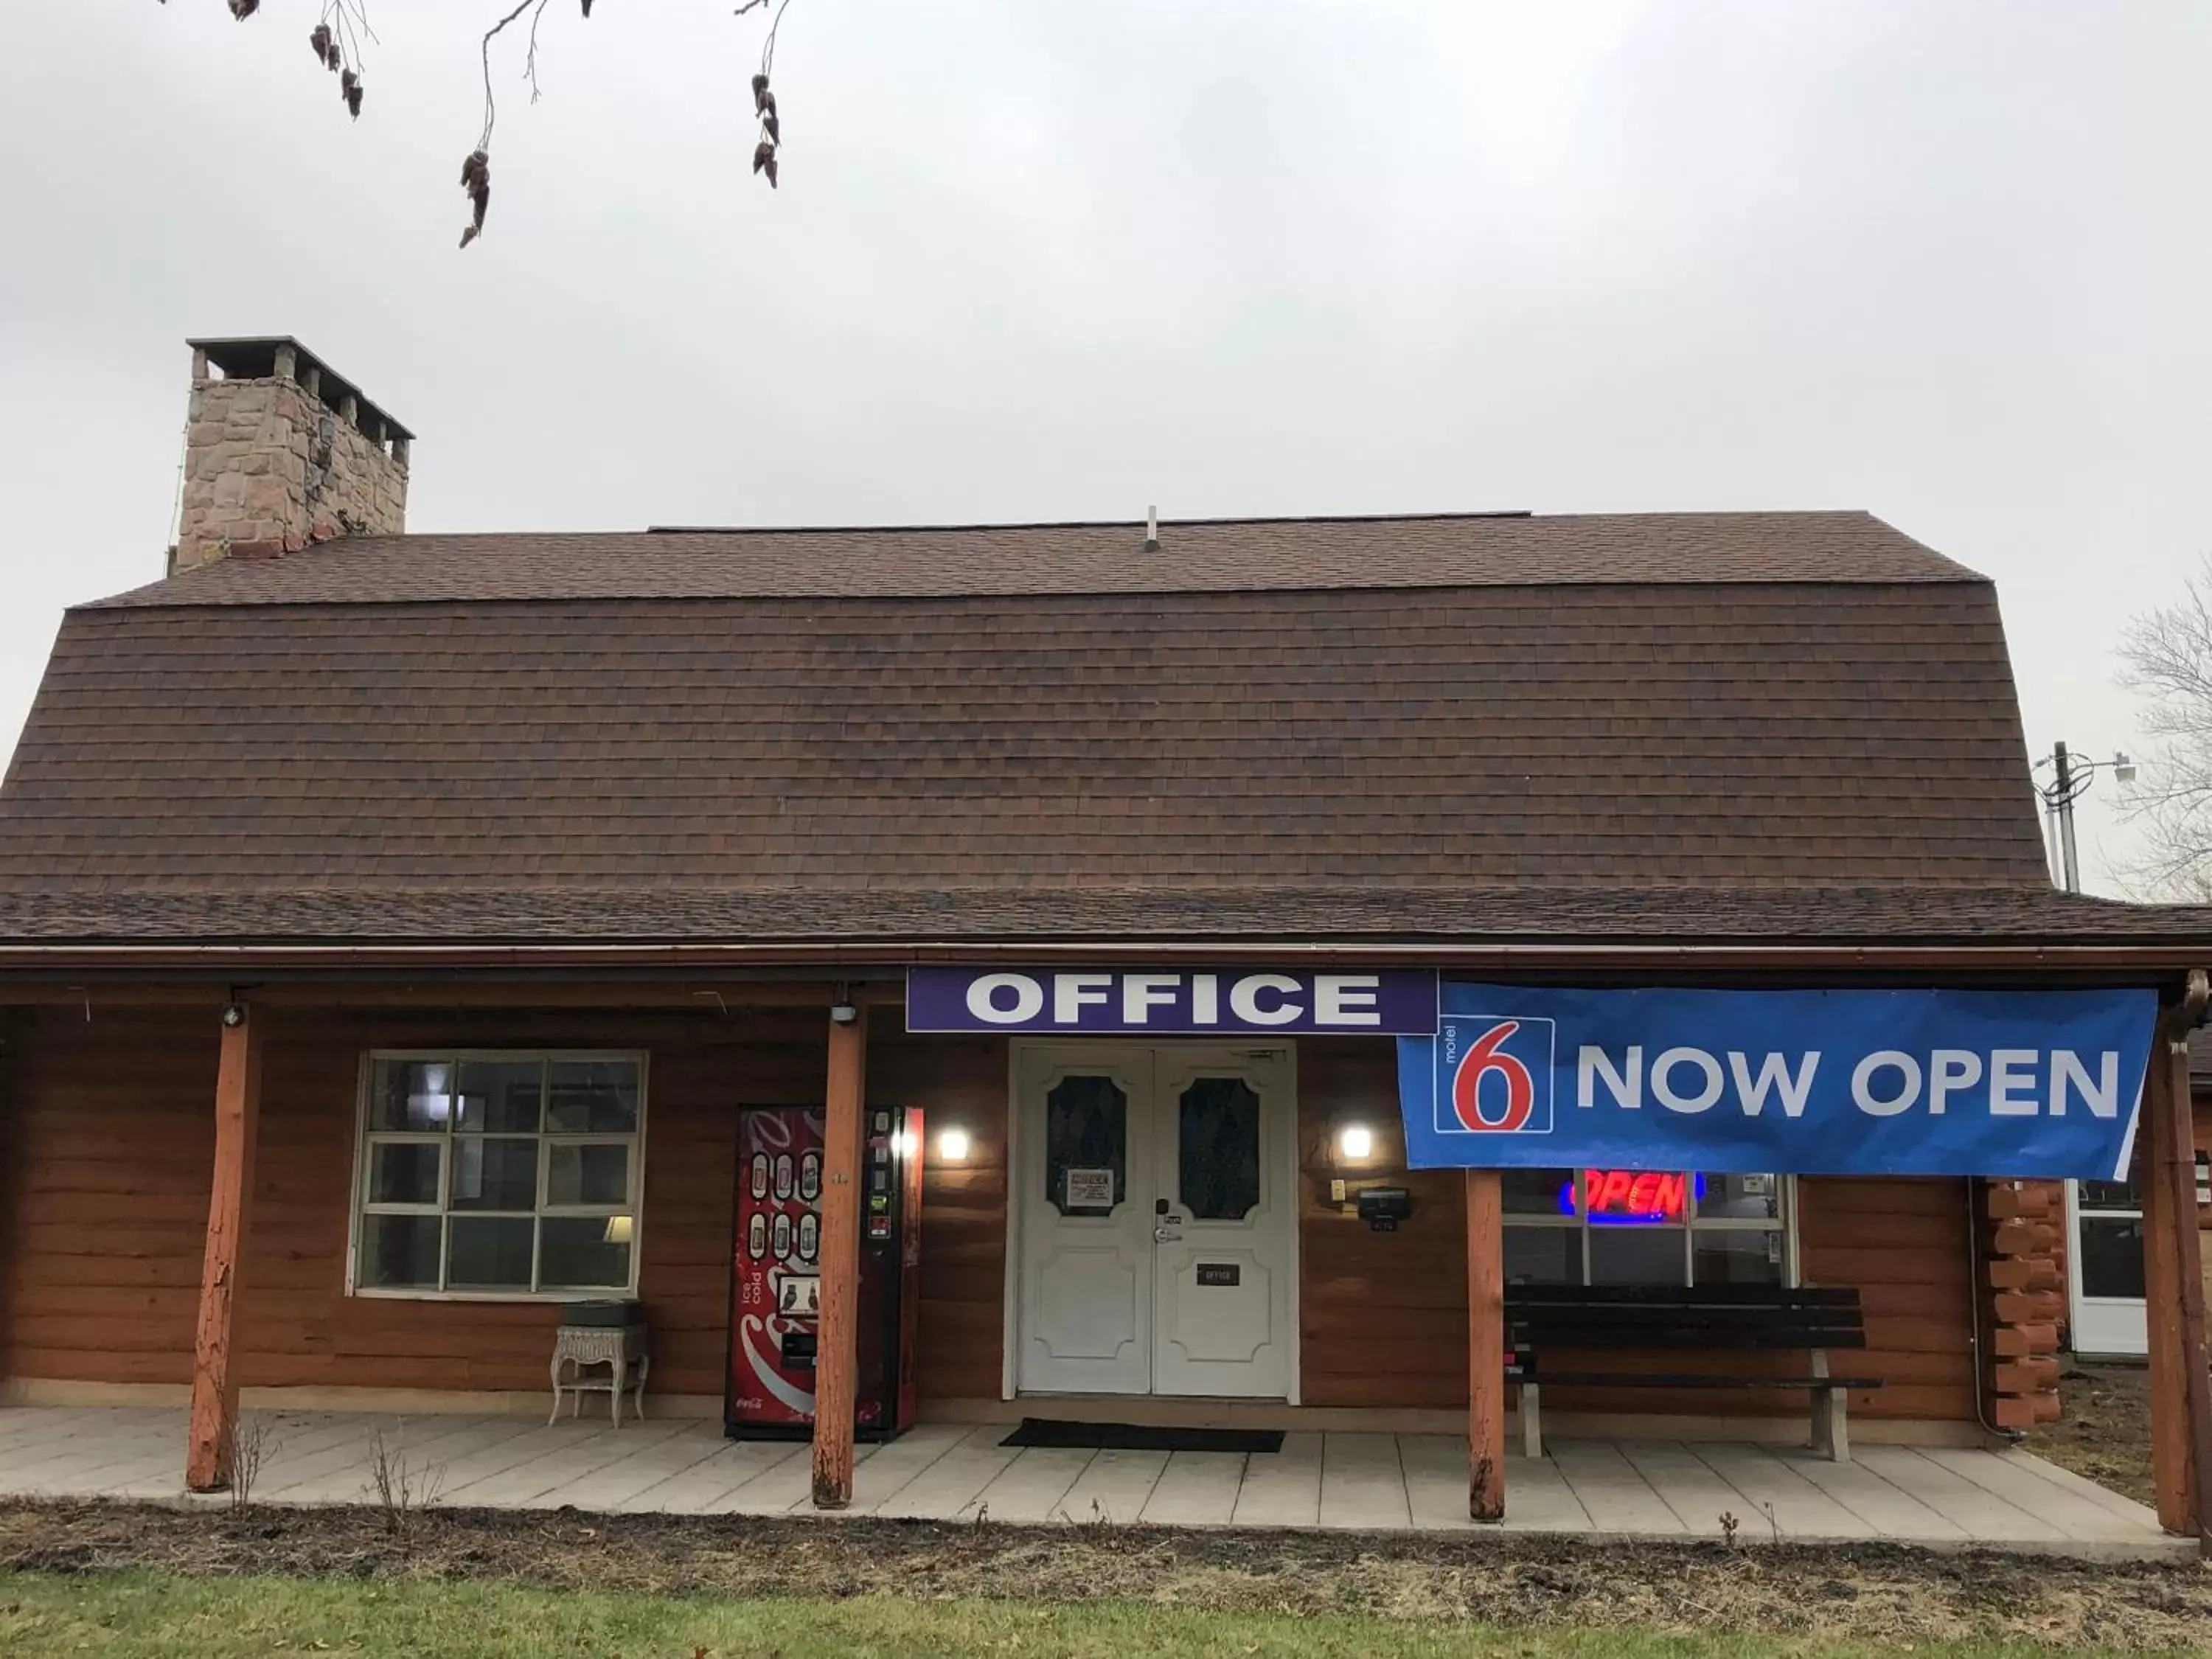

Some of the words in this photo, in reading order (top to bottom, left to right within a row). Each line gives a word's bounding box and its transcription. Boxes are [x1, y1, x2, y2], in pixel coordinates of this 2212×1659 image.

[966, 973, 1381, 1025] OFFICE
[1444, 1026, 1456, 1063] motel
[1453, 1020, 1534, 1133] 6
[1577, 1045, 1821, 1117] NOW
[1851, 1048, 2118, 1118] OPEN
[1570, 1168, 1685, 1216] OPEN
[742, 1283, 751, 1304] ice
[751, 1272, 762, 1304] cold
